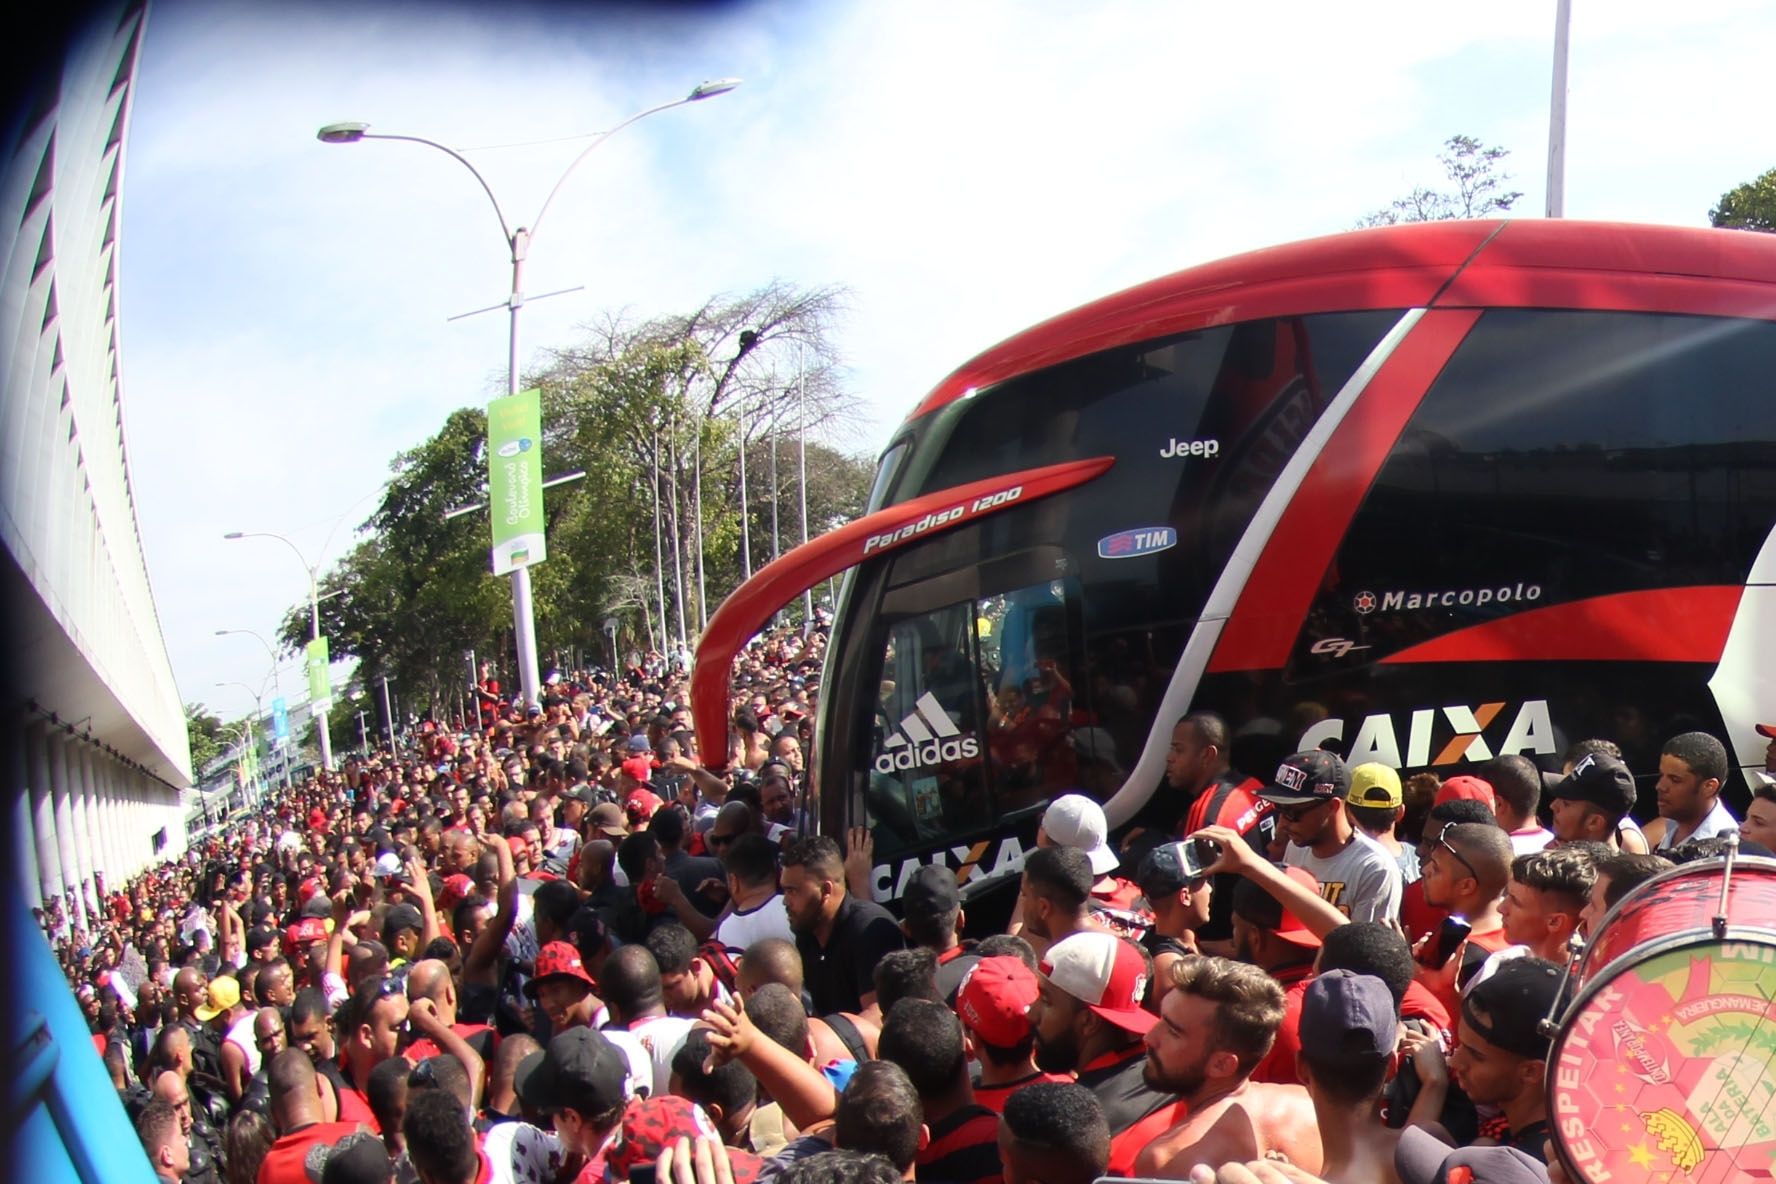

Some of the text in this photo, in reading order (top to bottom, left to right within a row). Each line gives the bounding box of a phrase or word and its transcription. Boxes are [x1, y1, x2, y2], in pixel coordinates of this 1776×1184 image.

[1160, 438, 1219, 459] Jeep
[863, 486, 1023, 555] Paradiso 1200
[1135, 531, 1168, 550] TIM
[1381, 583, 1542, 611] Marcopolo
[1297, 700, 1556, 769] CAIXA
[876, 737, 979, 774] adidas
